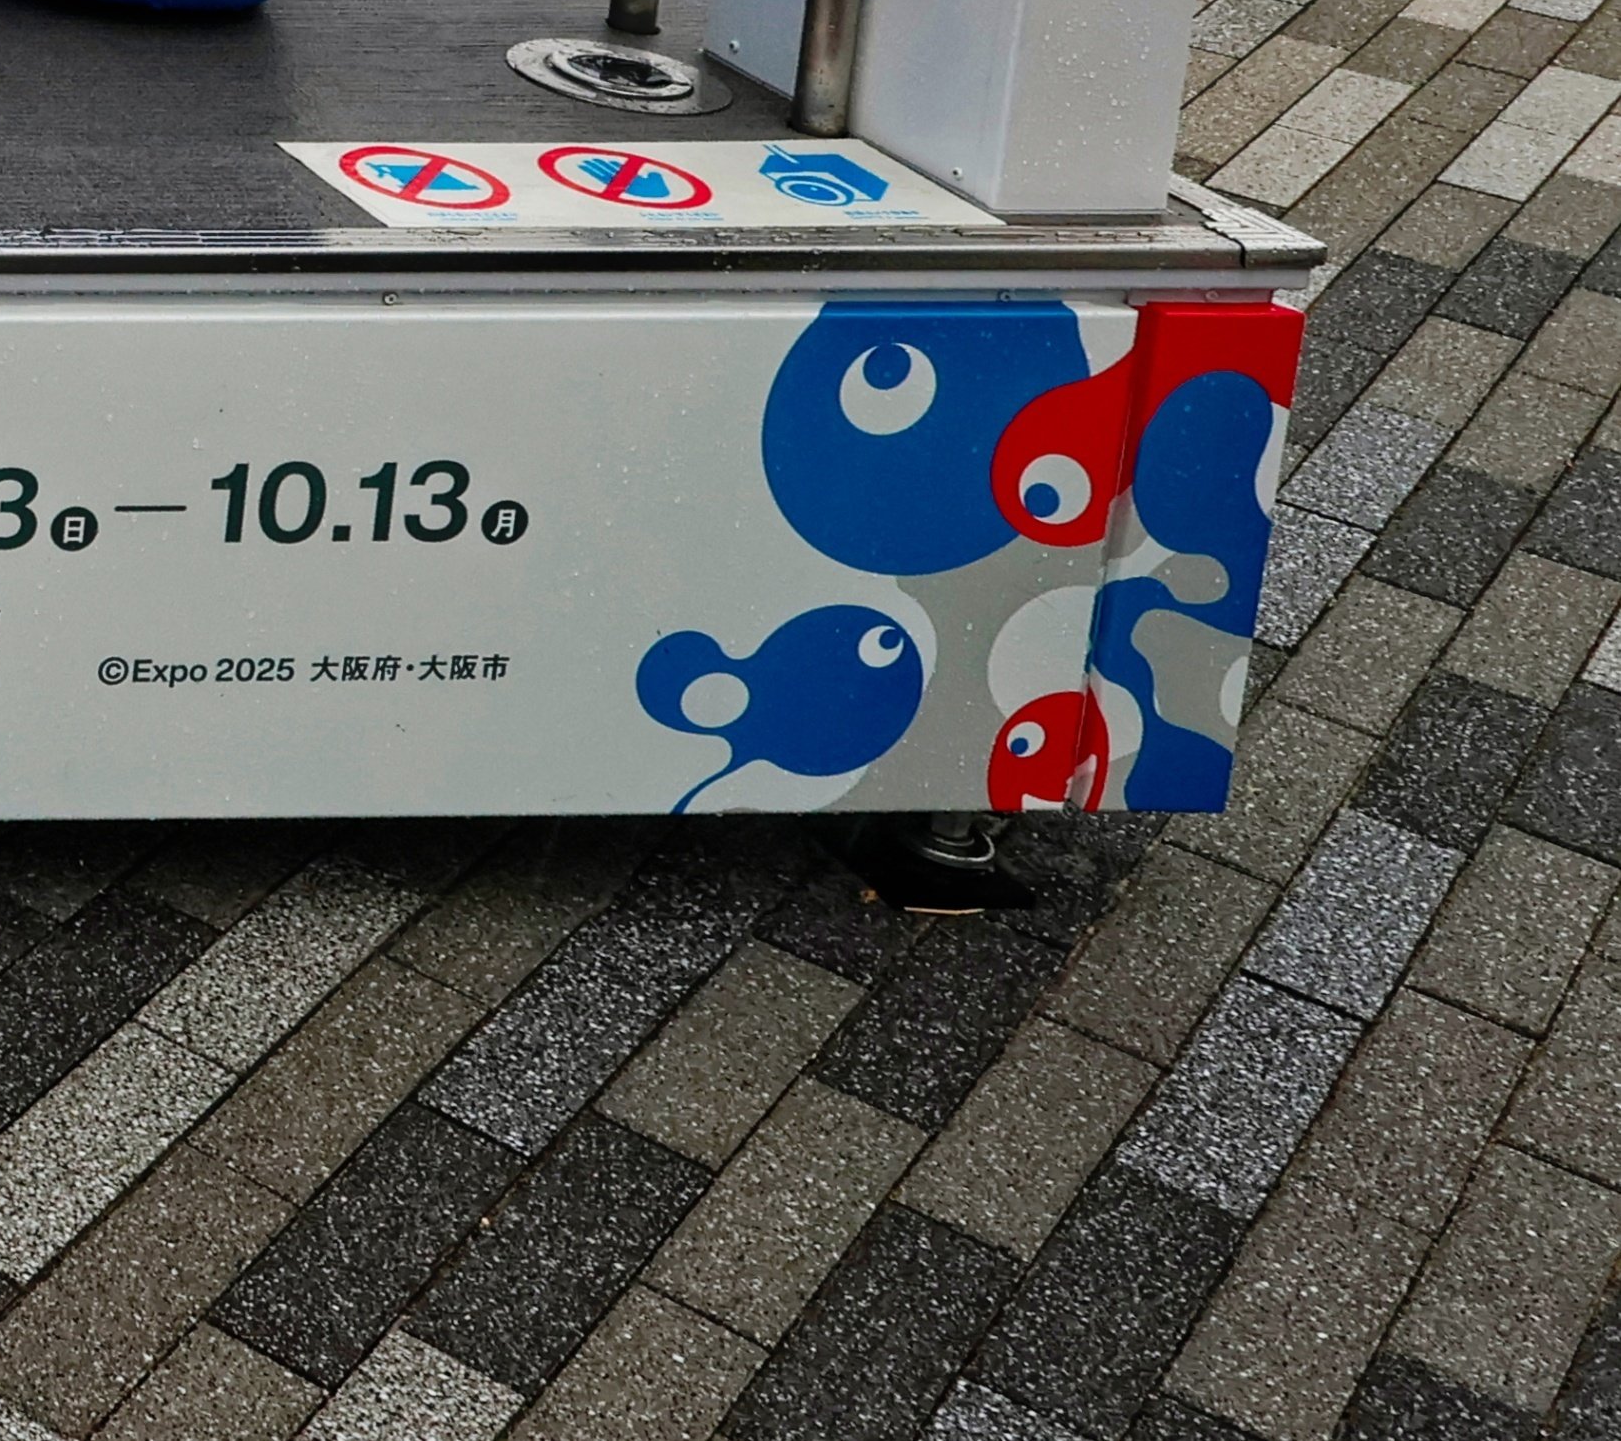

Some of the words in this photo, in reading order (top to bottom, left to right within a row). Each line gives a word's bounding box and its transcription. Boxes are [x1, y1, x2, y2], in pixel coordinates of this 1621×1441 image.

[215, 657, 295, 682] 2025
[310, 654, 511, 682] 大阪府・大阪市
